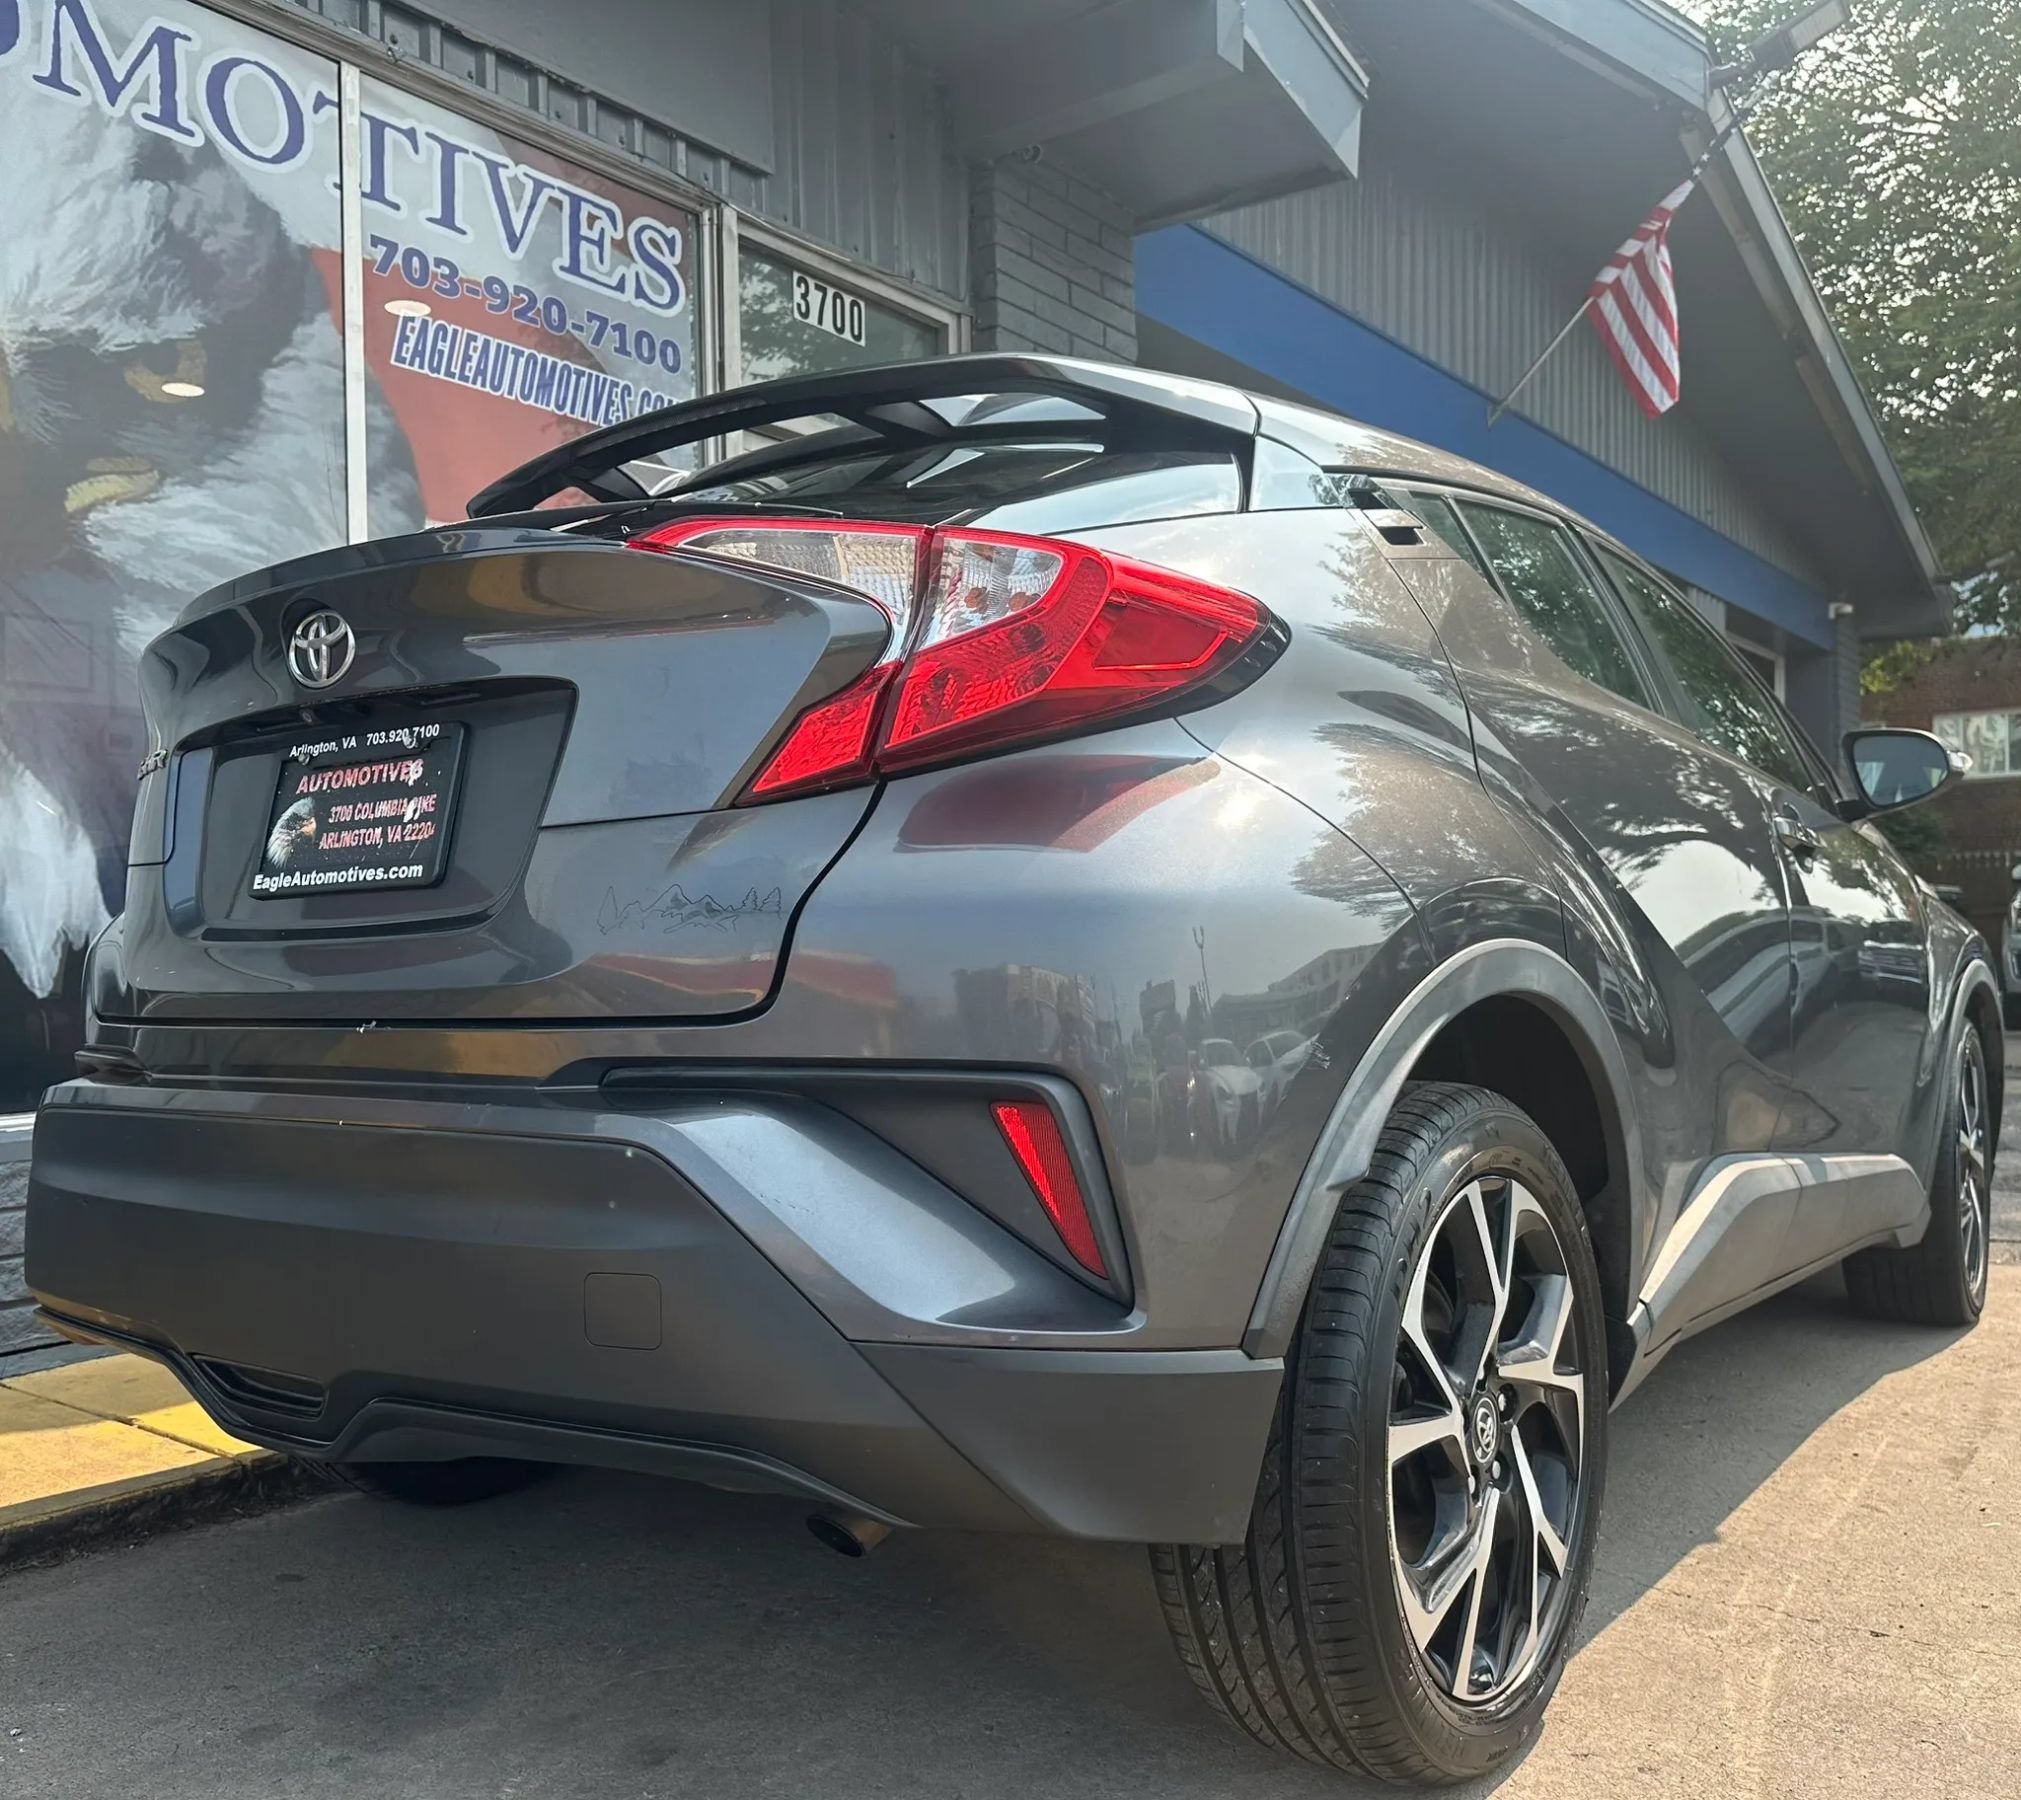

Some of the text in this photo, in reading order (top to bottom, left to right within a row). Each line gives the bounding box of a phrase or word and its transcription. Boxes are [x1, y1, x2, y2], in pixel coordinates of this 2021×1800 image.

[0, 0, 680, 310] MOTIVES
[369, 233, 682, 375] 703-920-7100
[796, 275, 862, 343] 3700
[393, 314, 681, 427] EAGLEAUTOMOTIVESC
[289, 723, 440, 757] Arlington, VA 703.9207100
[328, 804, 354, 823] 3700
[354, 797, 408, 820] COLUMBIA
[318, 826, 383, 850] ARLINGTON,
[388, 824, 402, 843] VA
[253, 864, 424, 893] EagleAutomotives.com
